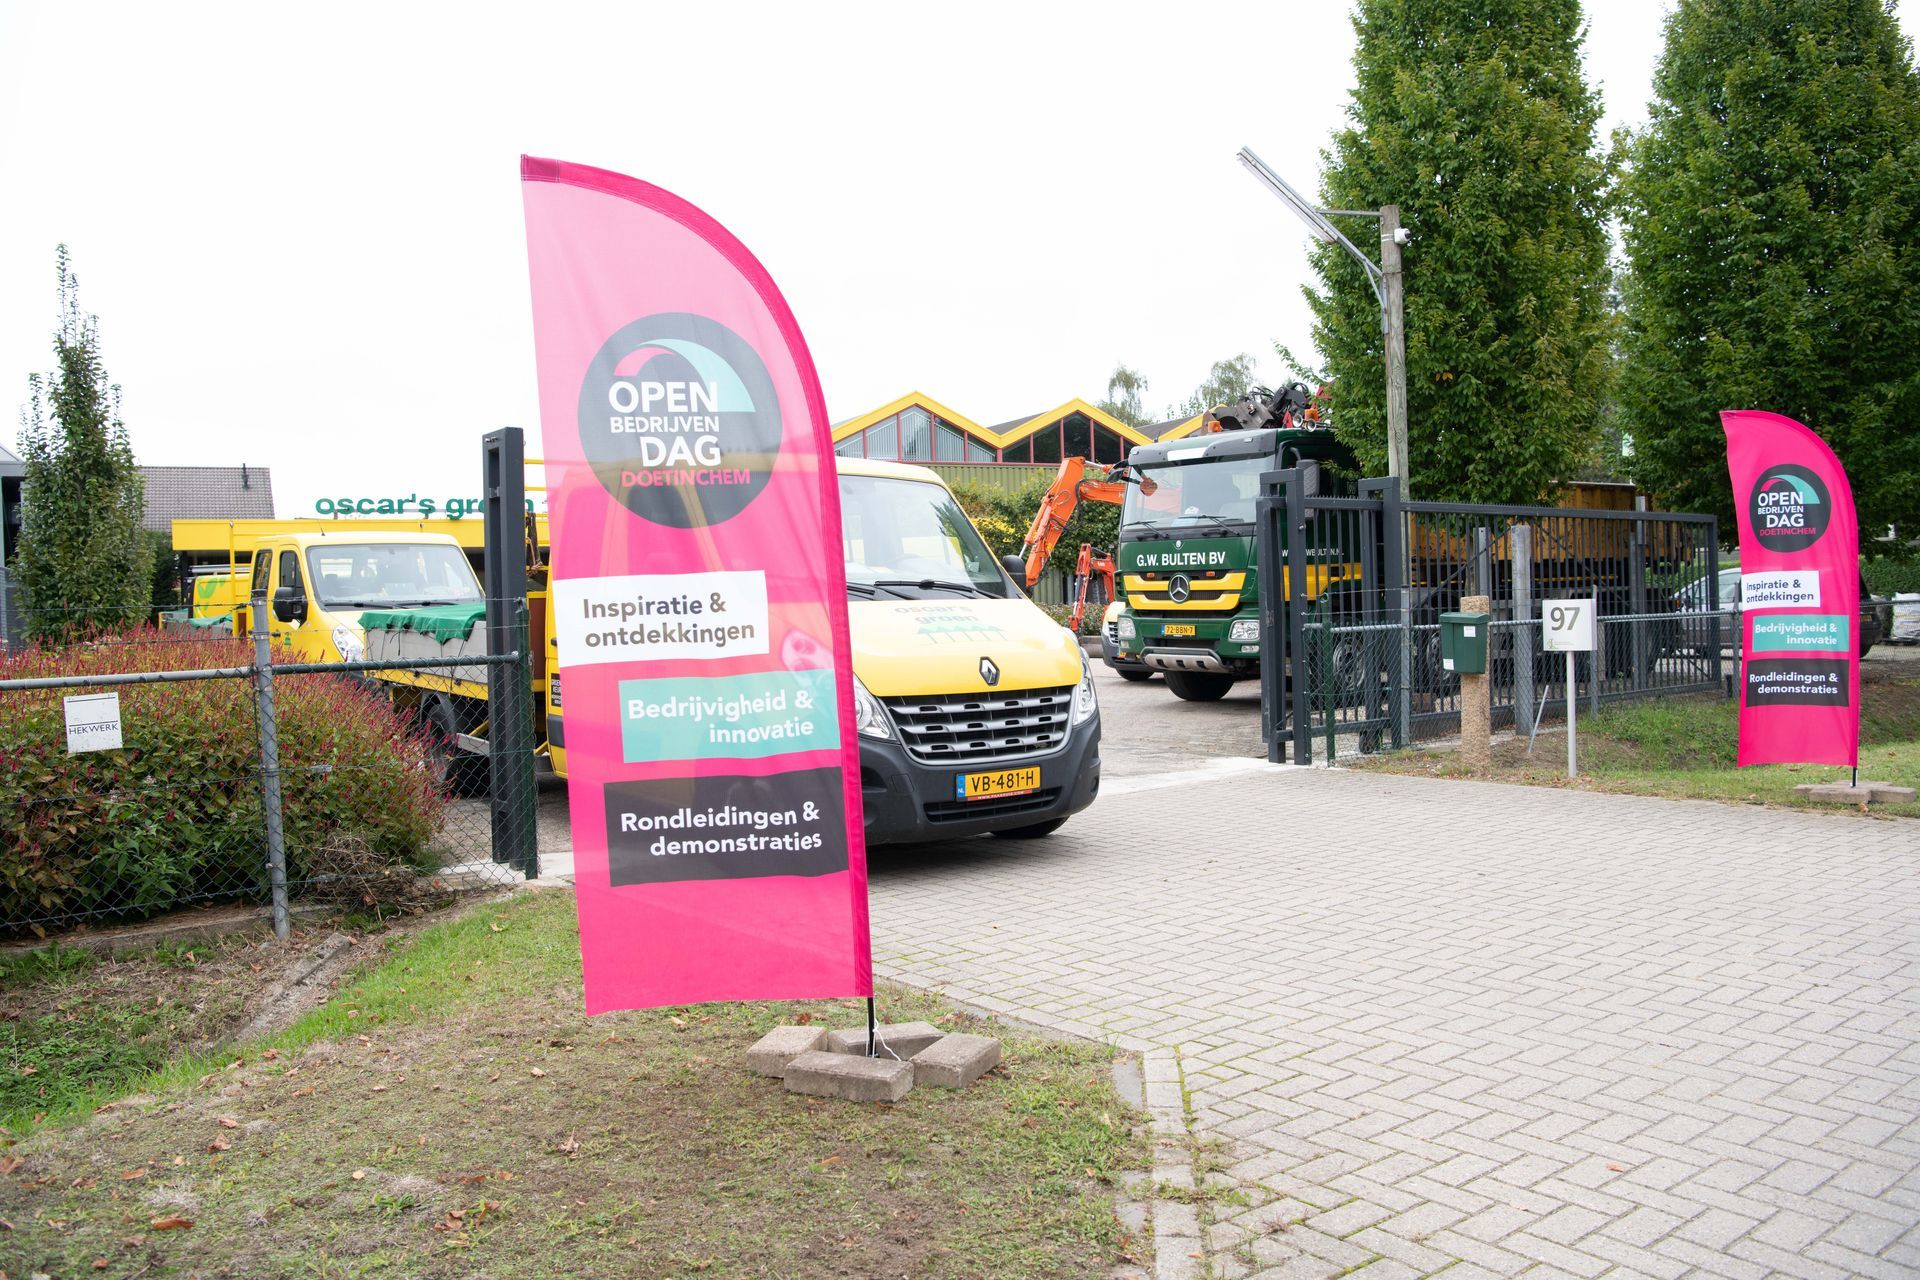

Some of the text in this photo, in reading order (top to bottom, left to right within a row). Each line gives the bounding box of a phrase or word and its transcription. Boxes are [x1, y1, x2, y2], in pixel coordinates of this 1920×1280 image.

[608, 380, 718, 413] OPEN
[610, 416, 719, 433] BEDRIJVEN
[640, 435, 722, 467] DAG
[621, 469, 751, 488] DOETINCHEM
[315, 493, 436, 515] oscar's
[1758, 492, 1803, 506] OPEN
[1757, 506, 1804, 515] BEDRIJVEN
[1766, 514, 1804, 528] DAG
[1760, 528, 1816, 536] DOETINCHEM
[1136, 551, 1226, 566] G.W. BULTEN BV
[1746, 579, 1801, 592] Inspiratie &
[1746, 591, 1815, 604] ontdekkingen
[583, 592, 727, 622] Inspiratie &
[1550, 606, 1580, 631] 97
[585, 623, 755, 648] ontdekkingen
[1166, 626, 1193, 634] 72-BBN-7
[1755, 622, 1837, 635] Bedrijvigheid &
[1787, 634, 1837, 645] innovatie
[1750, 672, 1838, 684] Rondleidingen &
[1758, 684, 1838, 695] demonstraties
[628, 690, 814, 722] Bedrijvigheid &
[69, 723, 118, 735] HEKWERK
[709, 718, 814, 743] innovatie
[971, 770, 1034, 793] VB-481-H
[621, 801, 820, 832] Rondleidingen &
[650, 832, 822, 856] demonstraties
